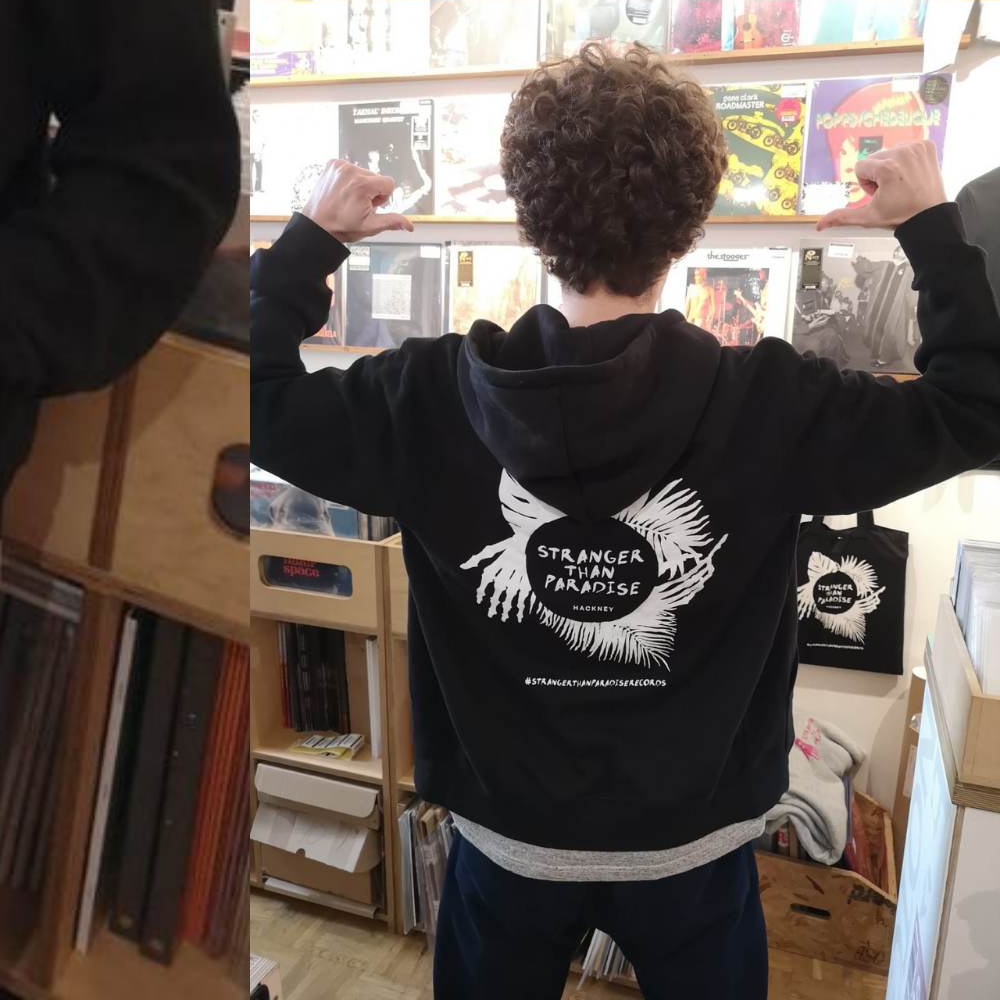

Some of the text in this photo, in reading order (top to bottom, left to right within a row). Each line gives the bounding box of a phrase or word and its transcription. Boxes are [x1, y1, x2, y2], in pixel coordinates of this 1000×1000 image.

[716, 100, 765, 110] ROADMASTER
[538, 545, 645, 565] STRANGER
[283, 565, 320, 578] space
[564, 565, 615, 579] THAN
[545, 574, 641, 596] PARADISE
[573, 604, 614, 612] HACKNEY
[525, 676, 667, 688] #STRANGERTHANPARADISERECORDS
